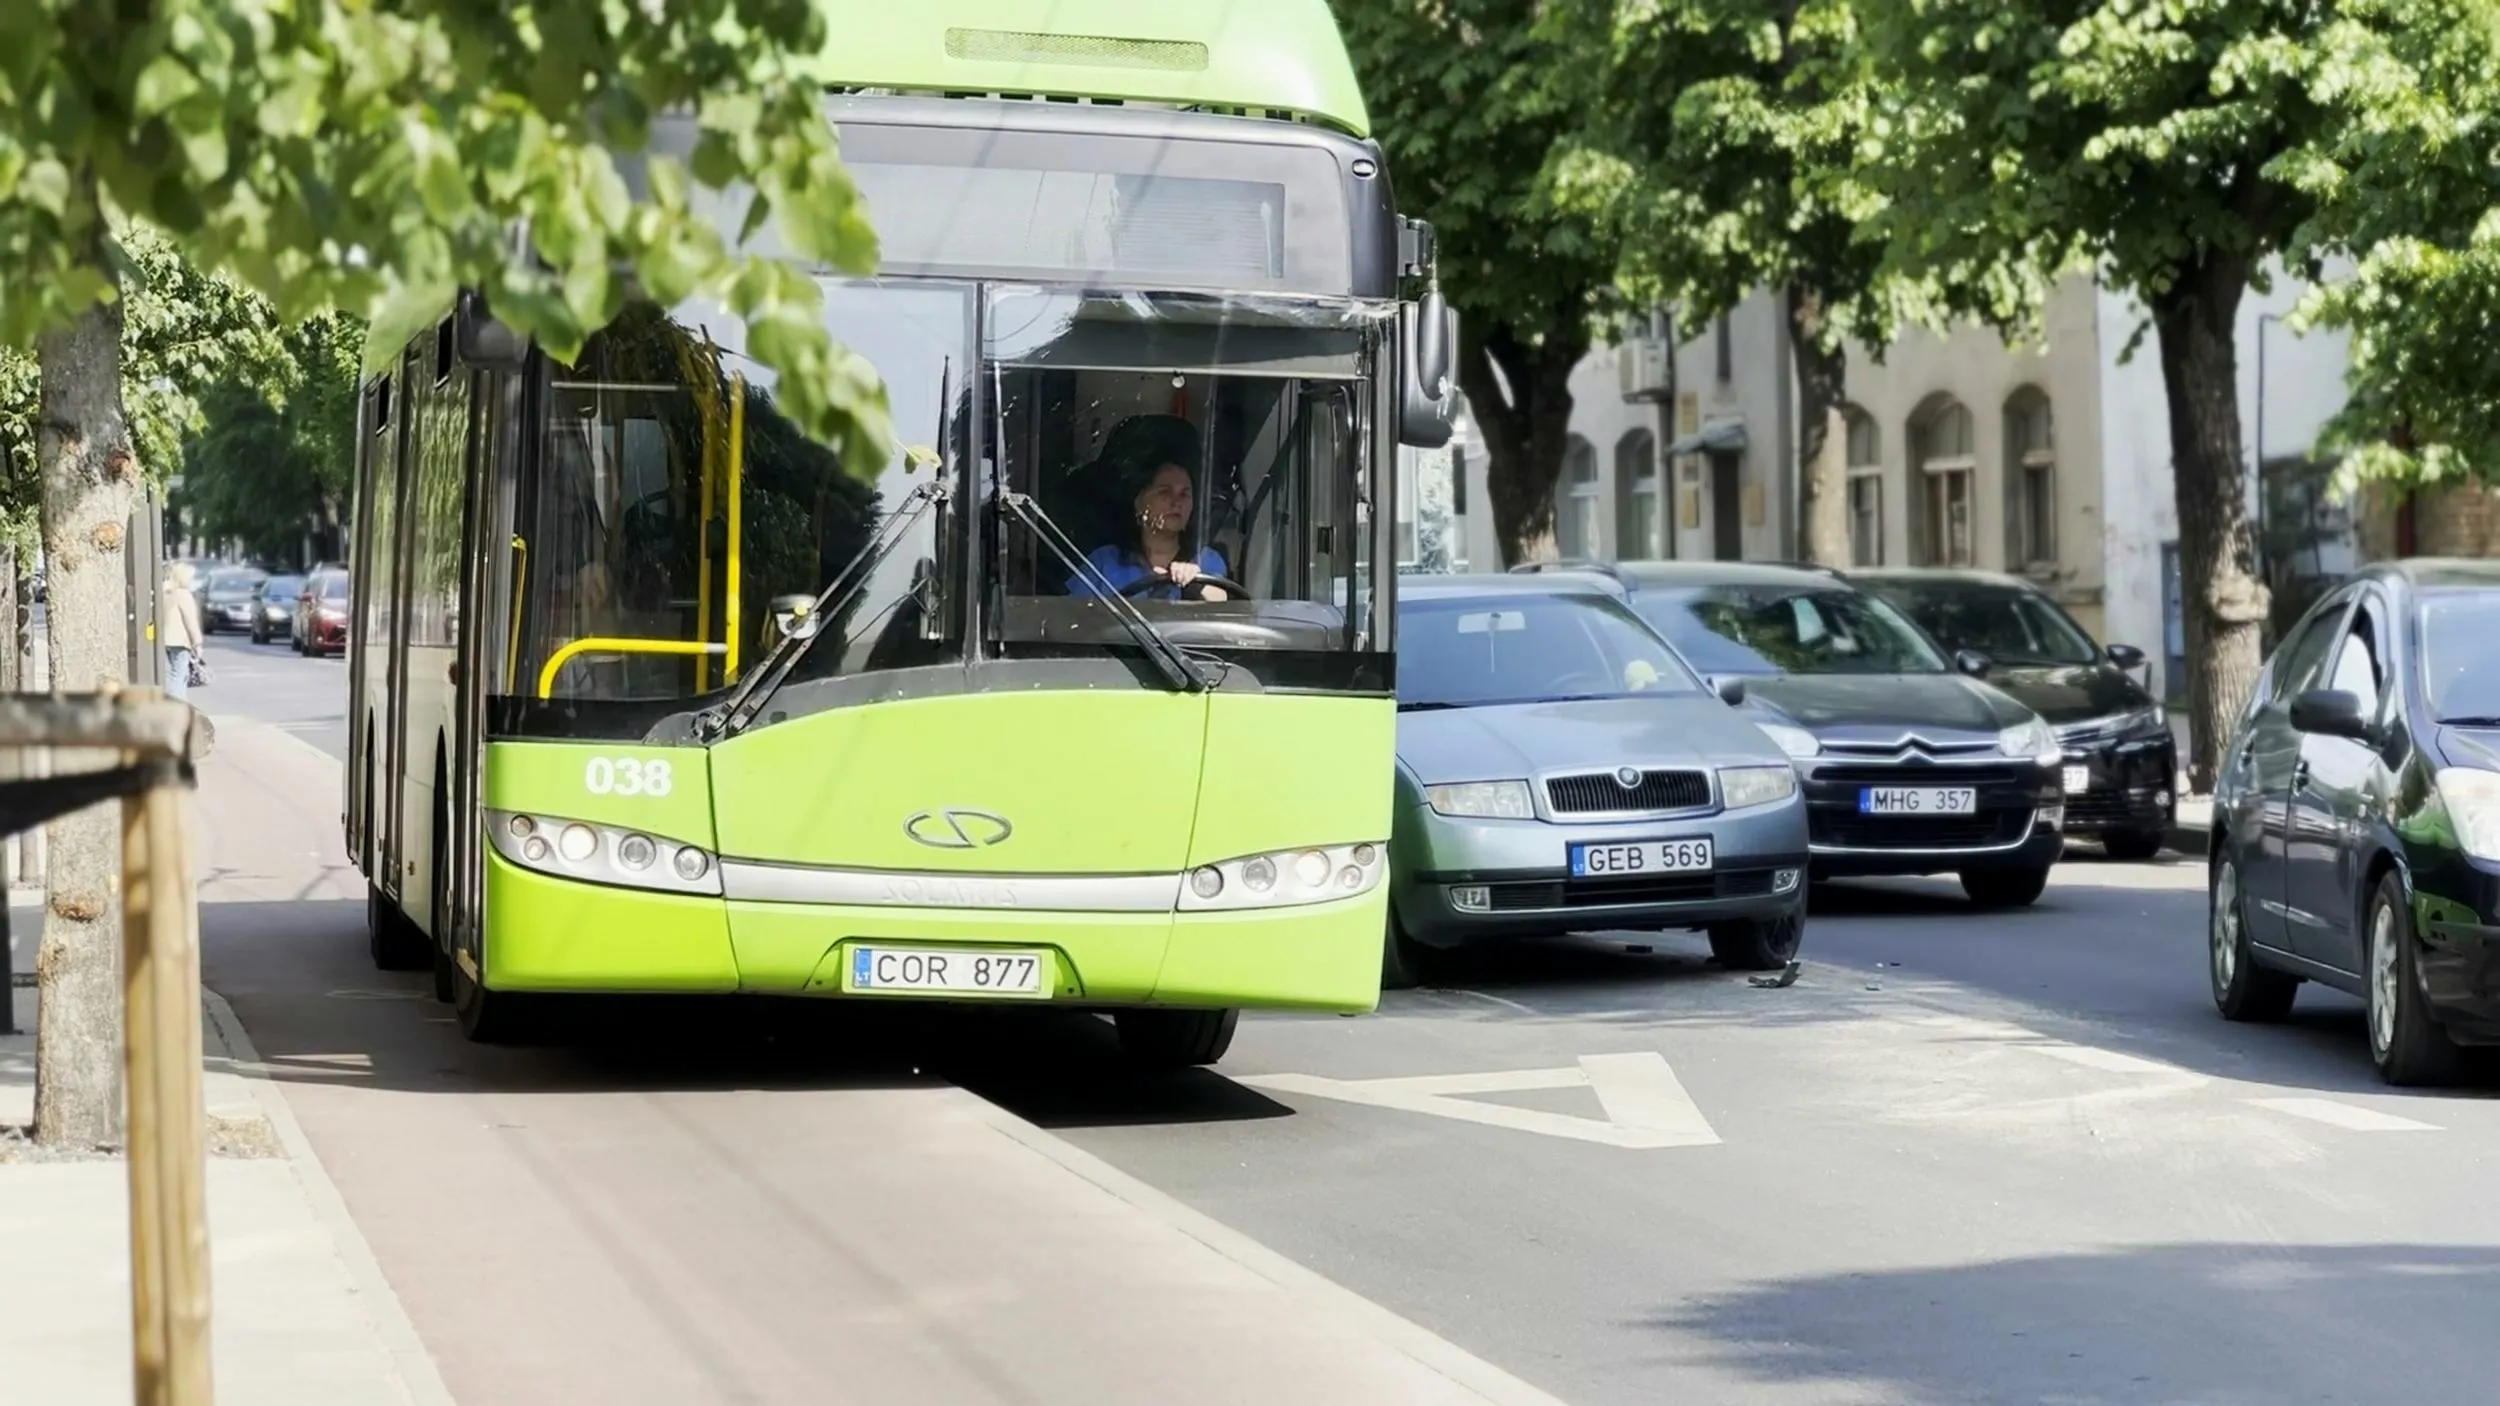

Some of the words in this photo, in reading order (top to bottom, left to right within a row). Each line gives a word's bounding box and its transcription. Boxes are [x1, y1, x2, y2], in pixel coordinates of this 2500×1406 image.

[585, 756, 672, 797] 038
[1874, 790, 1920, 810] MHG
[1935, 790, 1972, 810] 357
[1589, 846, 1644, 872] GEB
[1662, 842, 1708, 868] 569
[877, 954, 948, 985] COR
[974, 957, 1035, 987] 877
